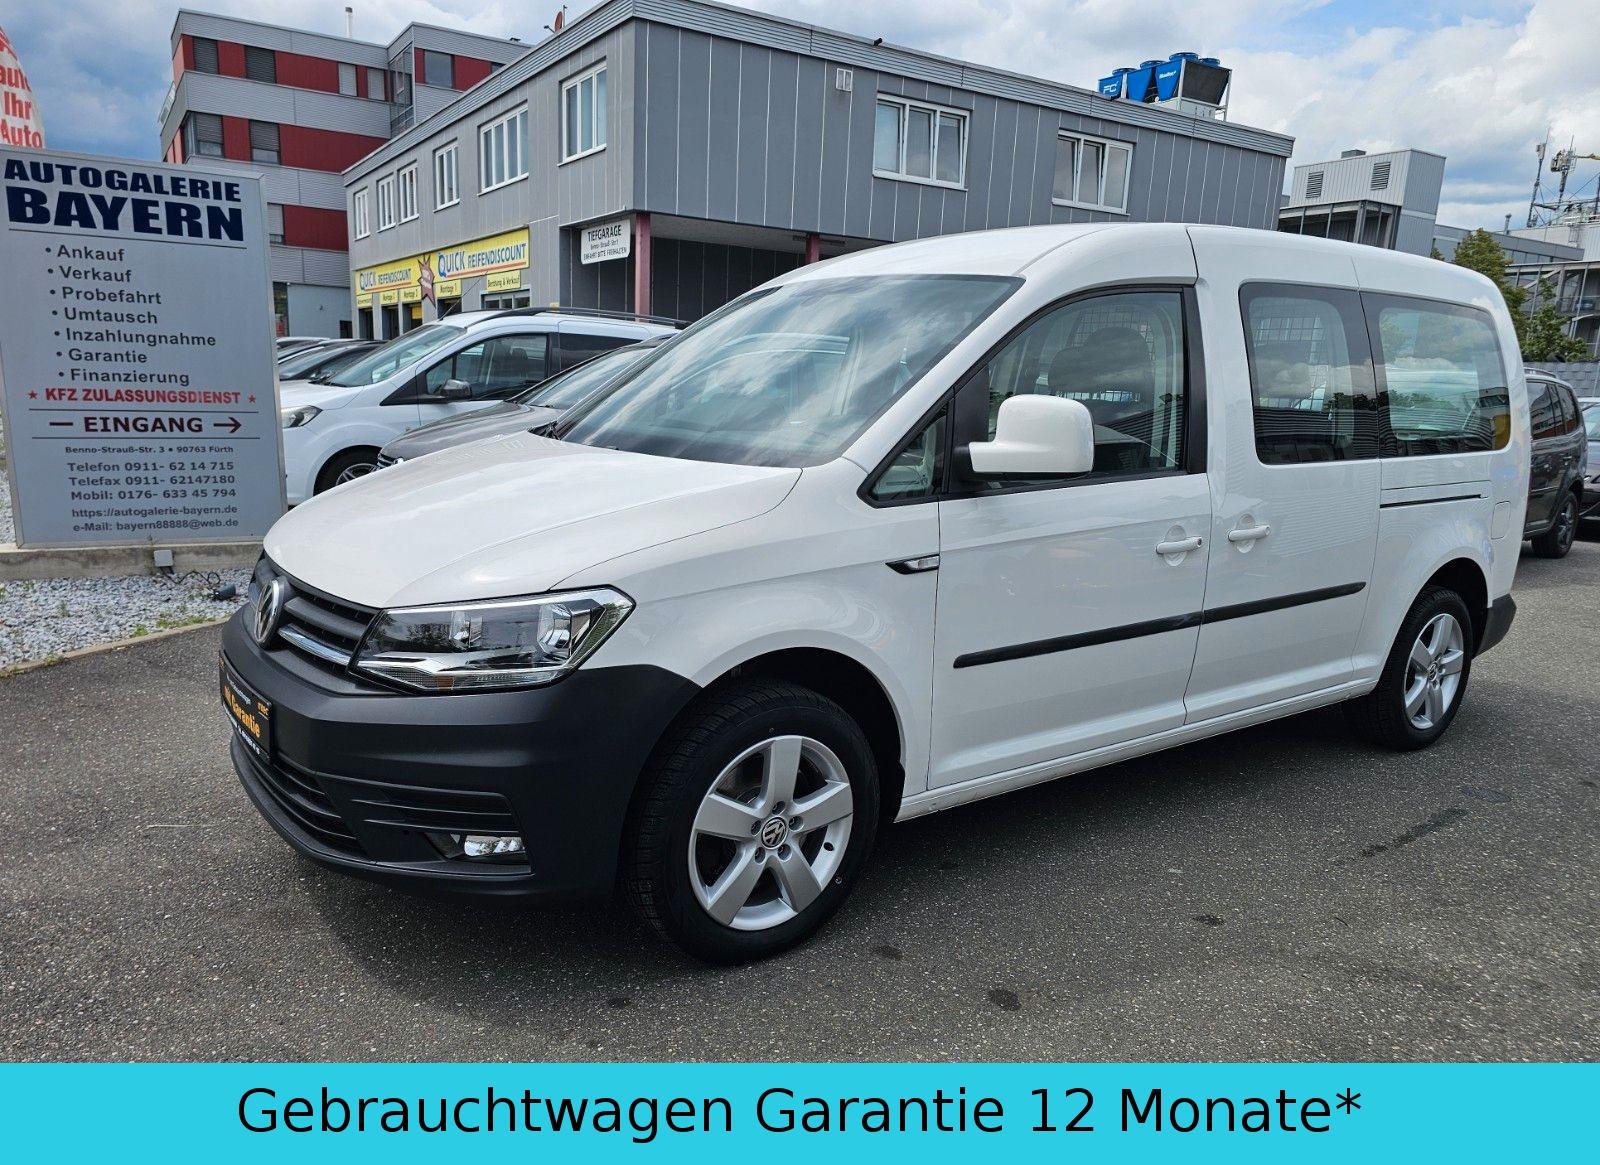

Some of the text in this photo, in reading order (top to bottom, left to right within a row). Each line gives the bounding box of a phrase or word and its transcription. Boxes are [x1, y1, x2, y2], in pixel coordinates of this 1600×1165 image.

[4, 91, 32, 120] Ihr
[0, 118, 43, 149] Auto
[4, 159, 241, 202] AUTOGALERIE
[6, 186, 244, 241] BAYERN
[588, 225, 622, 242] TIEFGARAGE
[57, 245, 125, 262] Ankauf
[437, 243, 527, 278] QUICK REIFENDISCOUNT
[59, 266, 132, 283] Verkauf
[62, 287, 162, 304] Probefahrt
[64, 307, 158, 324] Umtausch
[66, 328, 216, 346] Inzahlungnahme
[68, 350, 148, 363] Garantie
[71, 369, 190, 386] Finanzierung
[46, 388, 241, 404] KFZ ZULASSUNGSDIENST
[84, 417, 203, 433] EINGANG
[67, 461, 234, 472] Telefon 0911- 62 14 715
[68, 475, 235, 486] Telefax 0911- 62147180
[71, 488, 237, 500] Mobil: 0176- 633 45 794
[72, 505, 238, 518] https://autogalerie-bayern.de
[73, 521, 113, 532] e-Mail:
